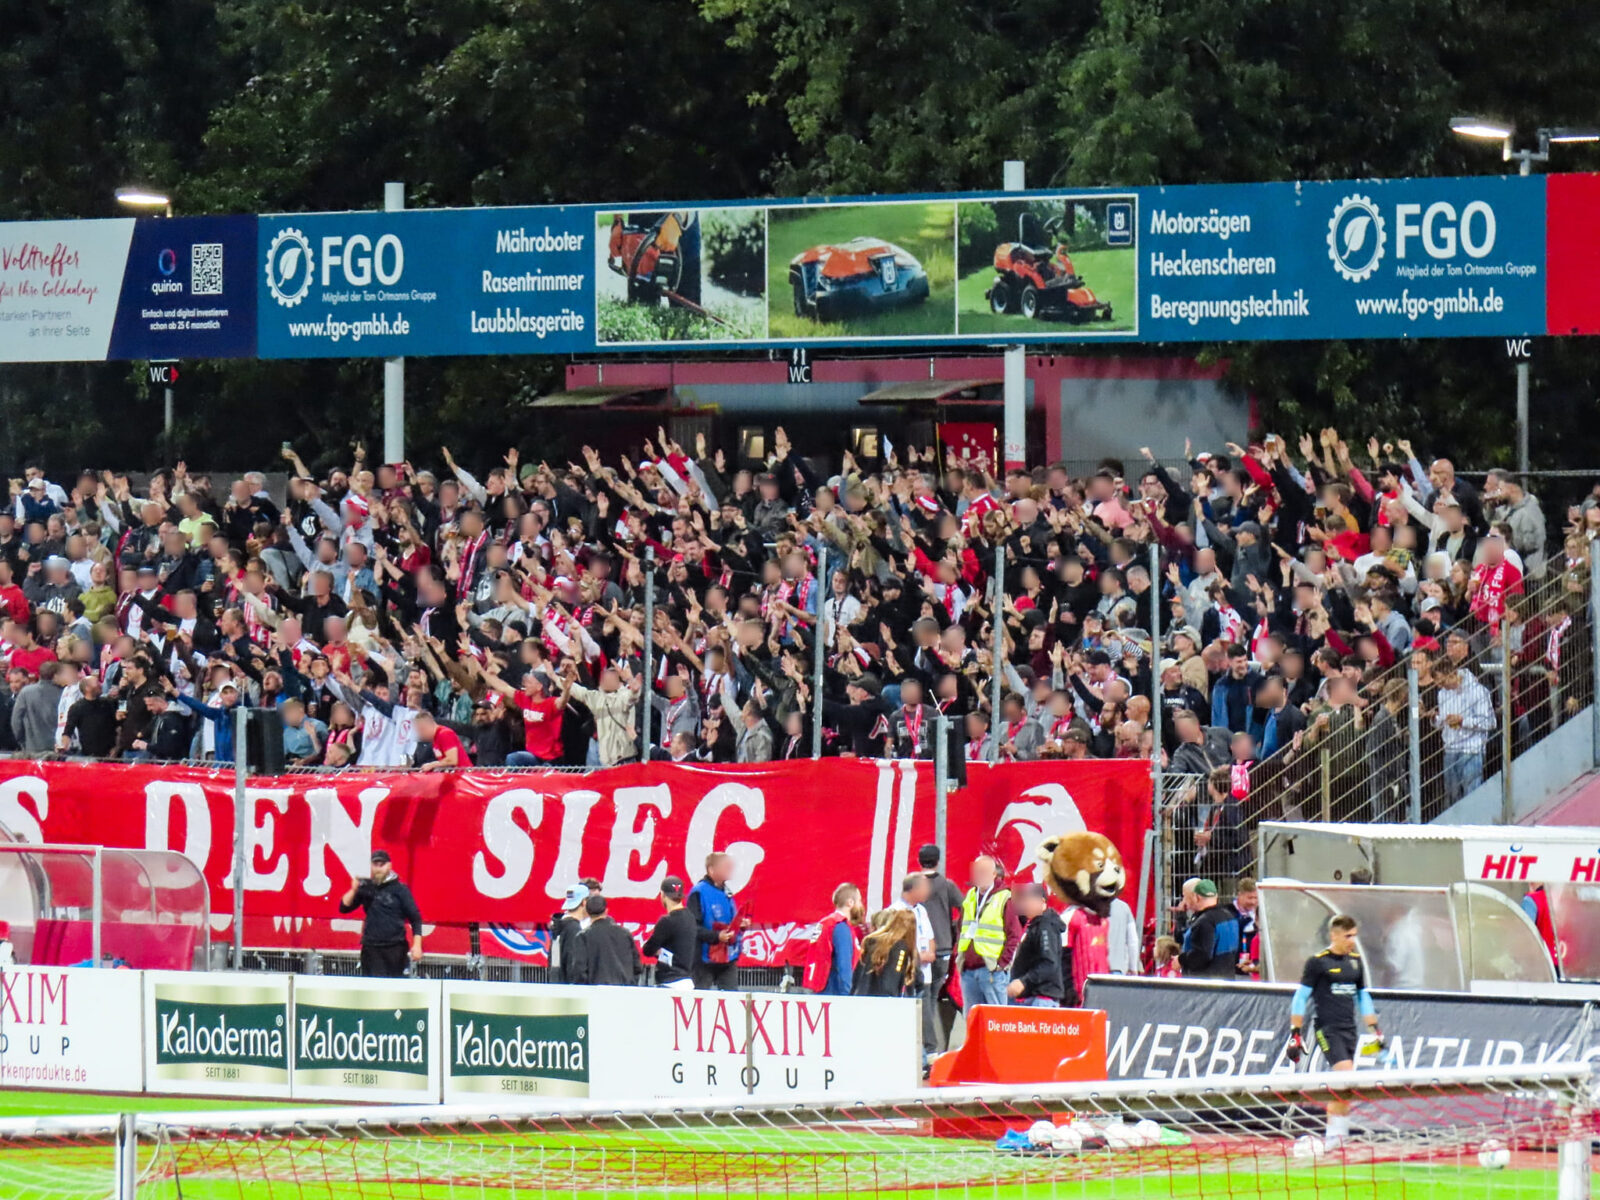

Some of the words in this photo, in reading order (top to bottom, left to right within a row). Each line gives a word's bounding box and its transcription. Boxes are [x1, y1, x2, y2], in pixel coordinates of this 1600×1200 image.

[1150, 208, 1251, 240] Motorsägen
[1395, 200, 1497, 259] FGO
[496, 226, 584, 253] Mähroboter
[321, 233, 404, 286] FGO
[1151, 248, 1276, 276] Heckenscheren
[1396, 264, 1429, 280] Mitglied
[1430, 263, 1445, 277] der
[1446, 263, 1462, 276] Tom
[1464, 262, 1504, 276] Ortmanns
[1505, 261, 1537, 278] Gruppe
[152, 279, 183, 295] quirion
[482, 268, 584, 293] Rasentrimmer
[322, 290, 350, 305] Mitglied
[350, 290, 362, 301] der
[363, 290, 376, 301] Tom
[411, 289, 437, 303] Gruppe
[1151, 289, 1310, 325] Beregnungstechnik
[1355, 287, 1504, 321] www.fgo-gmbh.de
[0, 310, 30, 321] tarken
[288, 312, 410, 342] www.fgo-gmbh.de
[471, 307, 585, 339] Laubblasgeräte
[65, 324, 91, 337] Seite
[1506, 339, 1531, 357] WC
[150, 366, 169, 382] WC
[789, 366, 810, 383] WC
[137, 779, 391, 897] DEN
[472, 781, 766, 900] SIEG
[1481, 854, 1538, 880] HIT
[671, 996, 833, 1058] MAXIM
[988, 1020, 1001, 1032] Die
[1001, 1021, 1017, 1033] rote
[1018, 1021, 1038, 1034] Bank.
[1039, 1022, 1051, 1035] För
[205, 1066, 221, 1078] SEIT
[223, 1067, 240, 1079] 1881
[343, 1072, 359, 1084] SEIT
[361, 1073, 378, 1085] 1881
[671, 1062, 835, 1090] GROUP
[501, 1079, 518, 1091] SEIT
[520, 1080, 538, 1092] 1881
